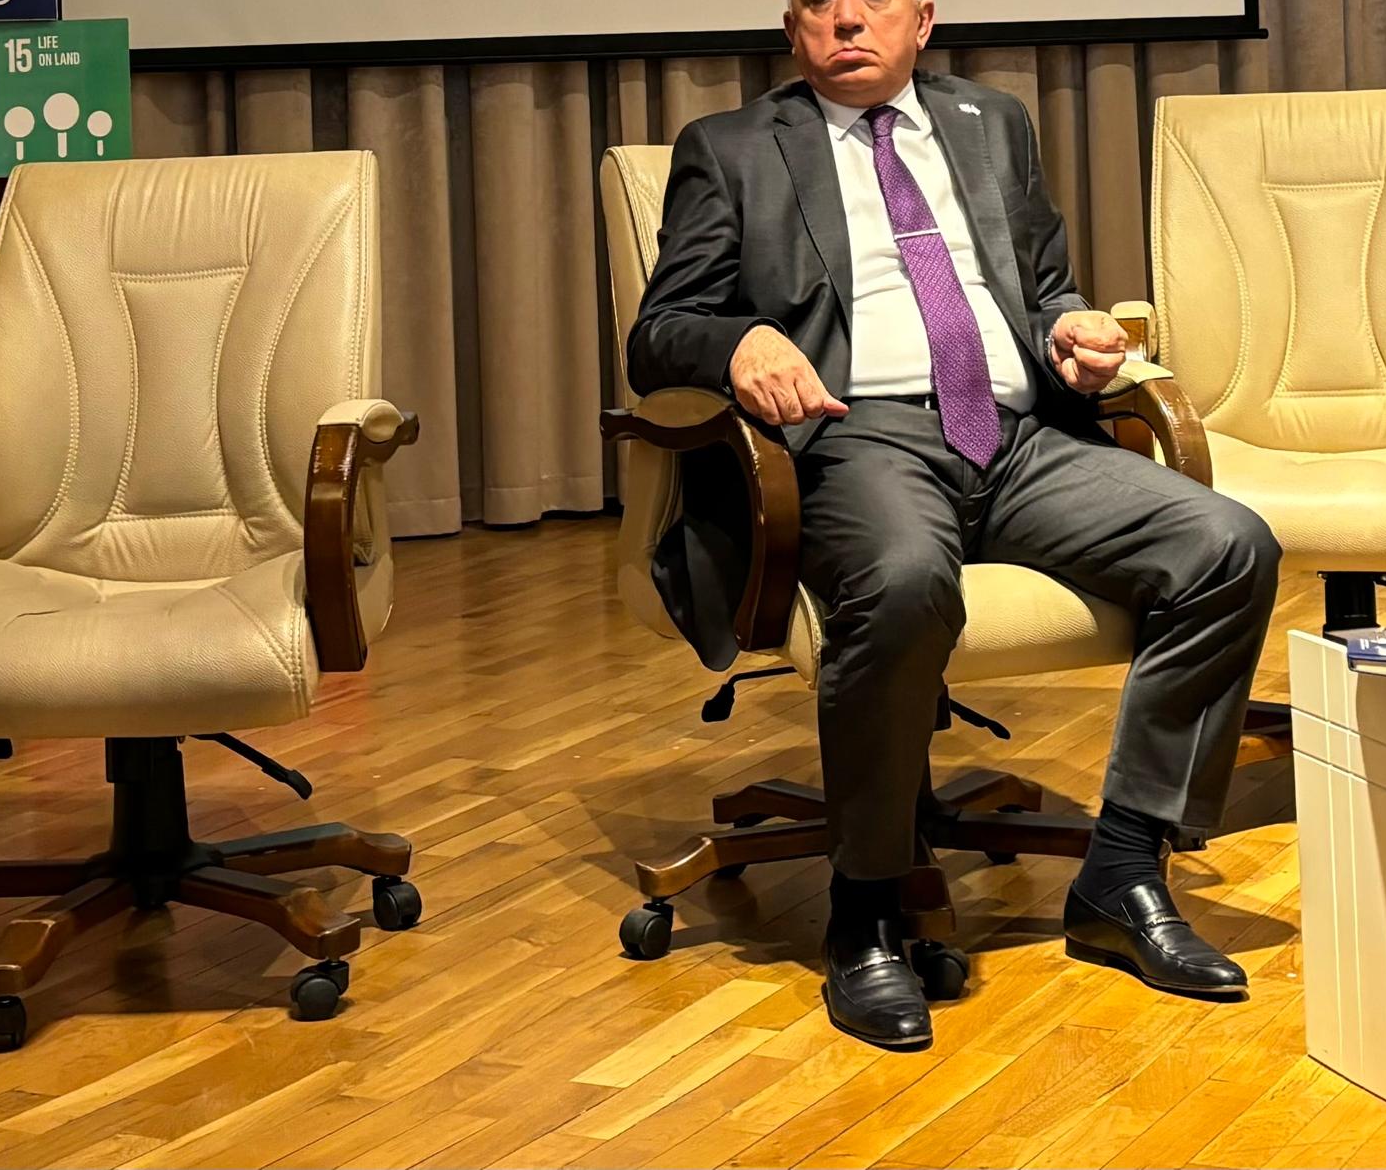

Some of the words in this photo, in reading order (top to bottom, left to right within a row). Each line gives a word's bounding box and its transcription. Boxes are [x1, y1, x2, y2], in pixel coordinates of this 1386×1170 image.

[4, 38, 32, 73] 15
[37, 36, 59, 49] LIFE
[39, 53, 52, 66] ON
[55, 52, 80, 66] LAND
